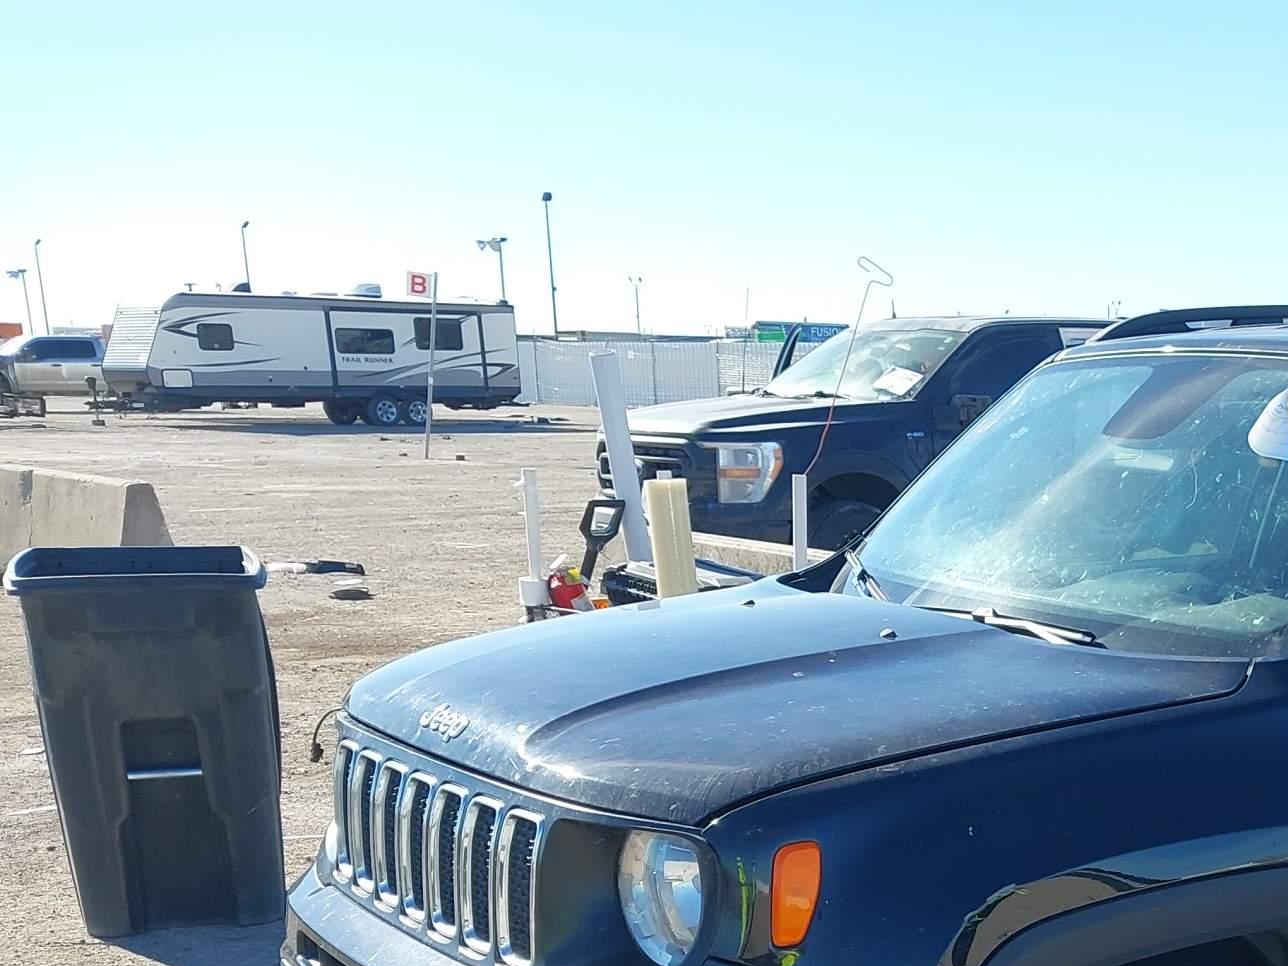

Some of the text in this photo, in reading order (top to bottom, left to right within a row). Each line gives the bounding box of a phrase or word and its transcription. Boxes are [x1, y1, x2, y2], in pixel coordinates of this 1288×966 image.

[411, 274, 426, 293] B
[811, 327, 841, 337] FUSIO
[419, 702, 471, 744] Jeep
